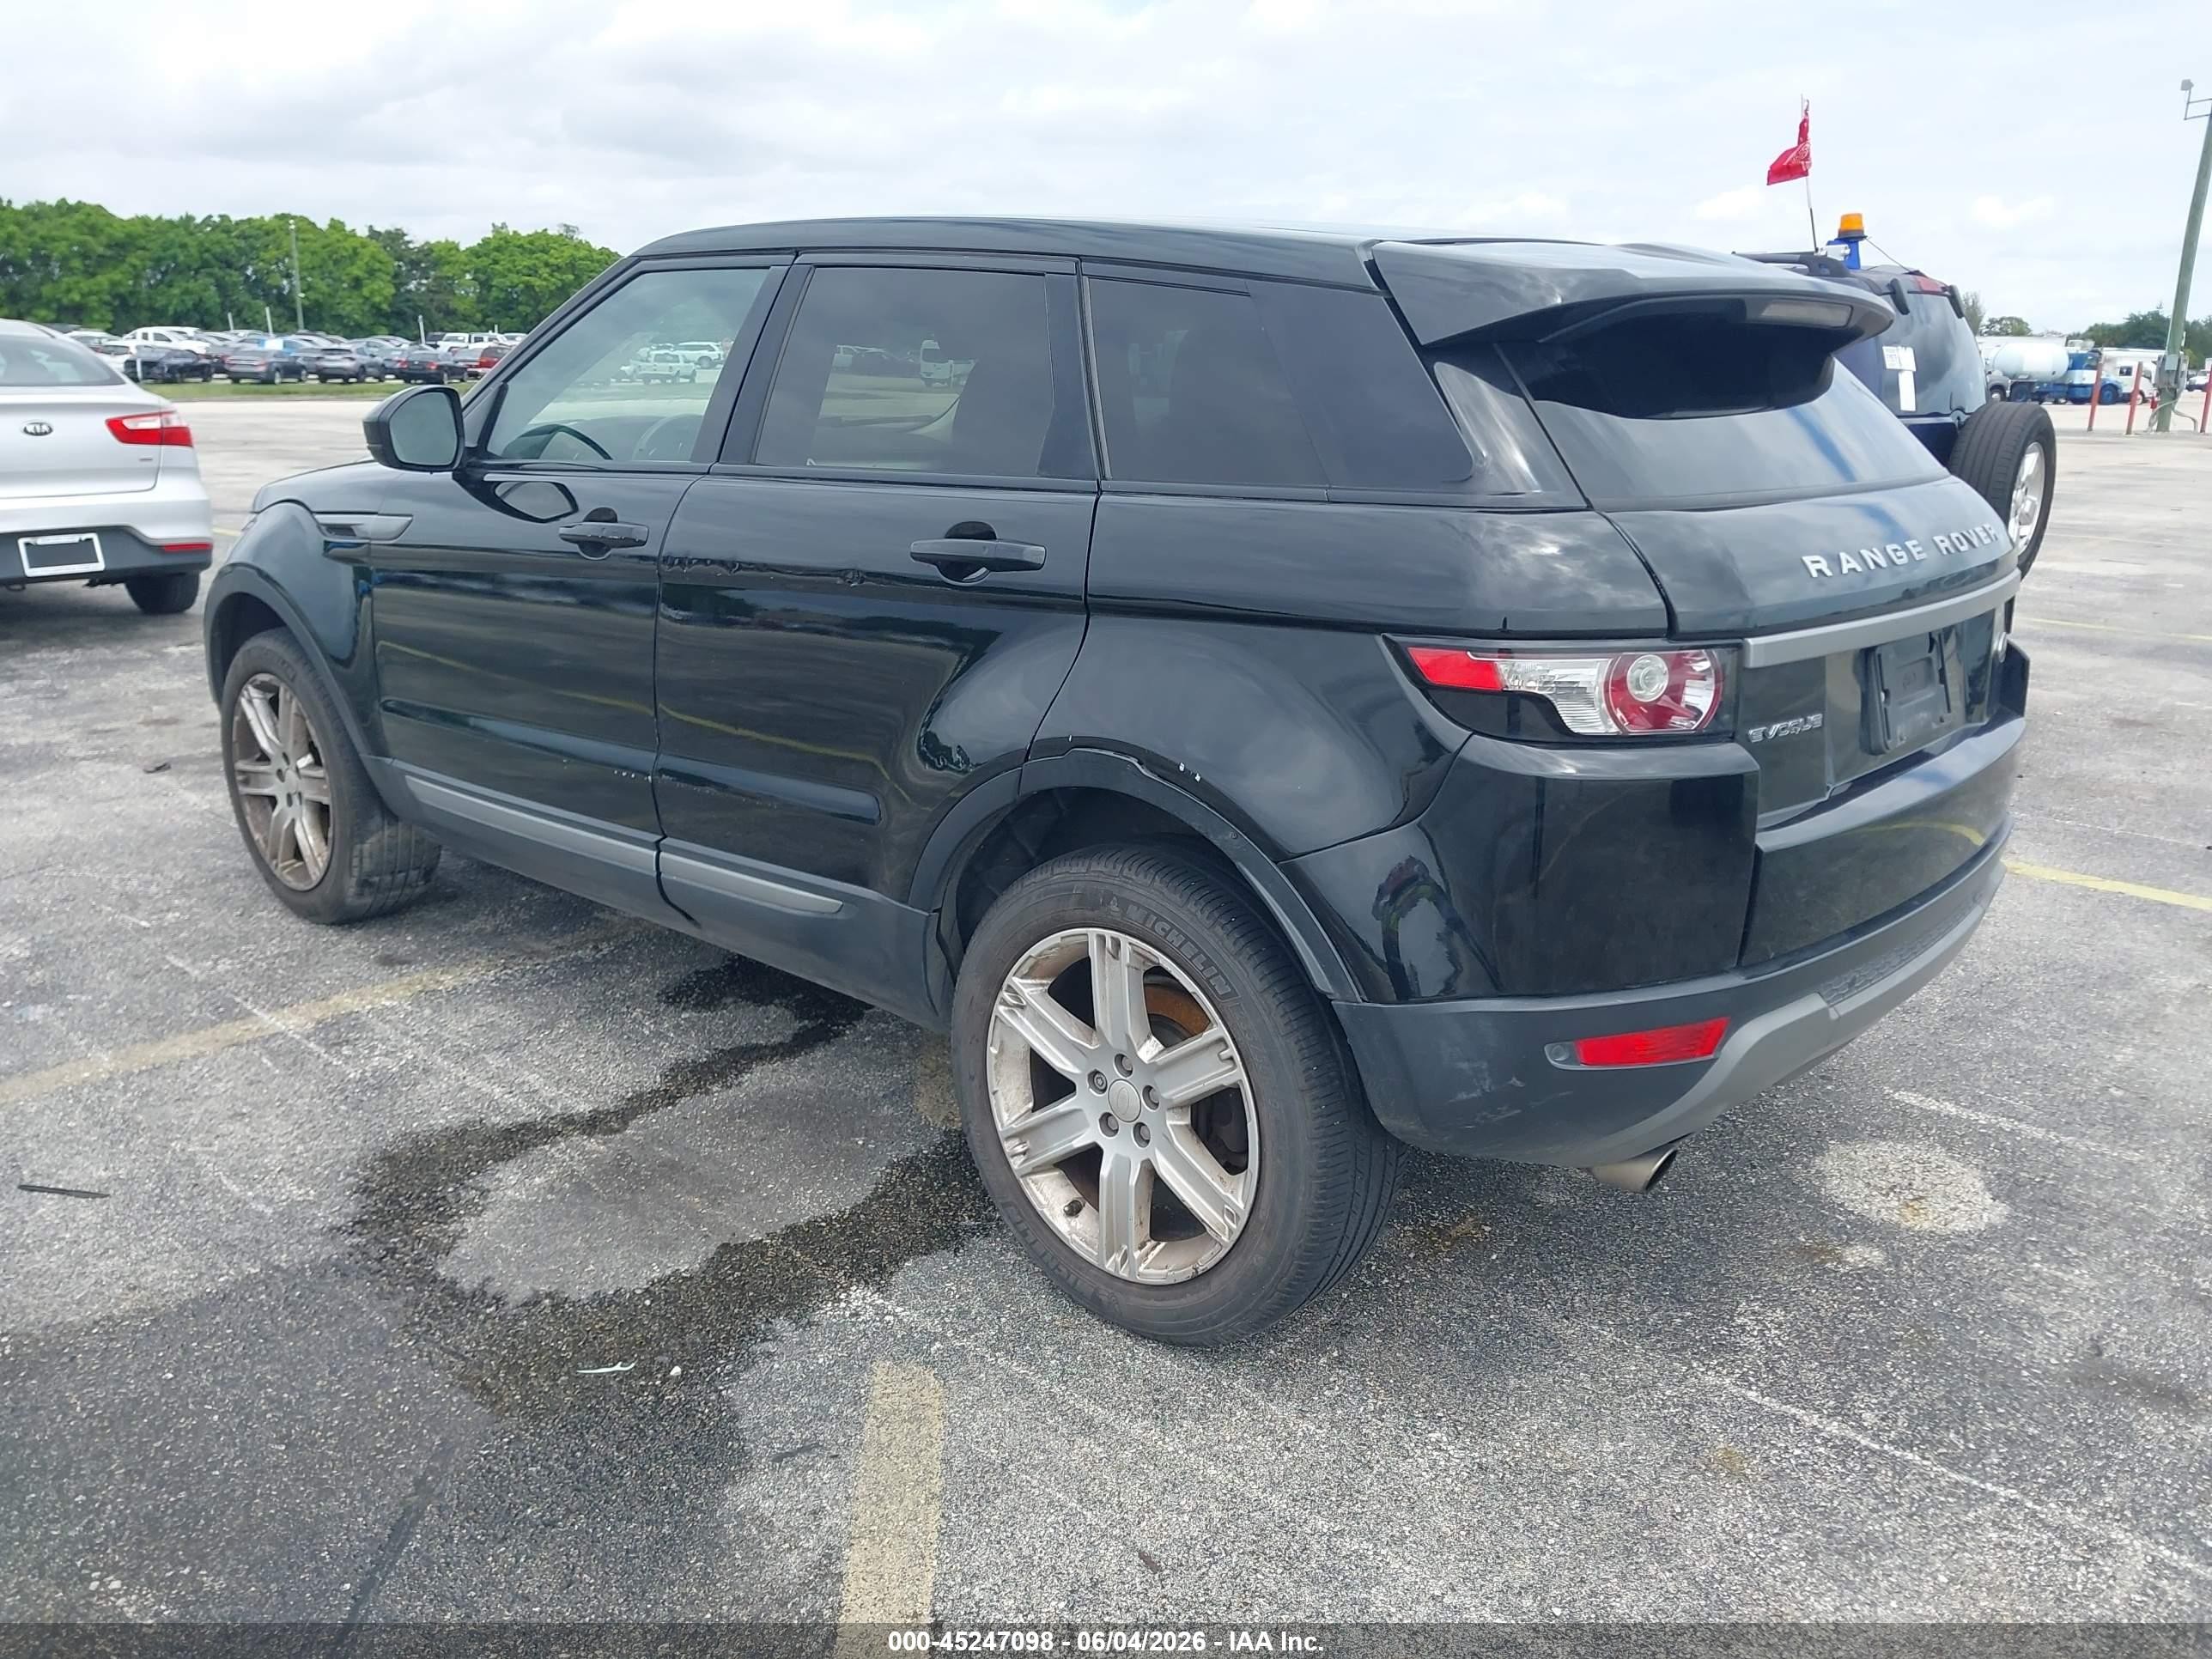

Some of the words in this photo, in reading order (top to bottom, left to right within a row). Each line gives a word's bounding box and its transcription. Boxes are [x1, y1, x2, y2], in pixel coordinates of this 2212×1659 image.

[23, 420, 53, 436] KIA
[1801, 539, 1928, 578] RANGE
[1931, 523, 1999, 556] ROVER
[1748, 713, 1823, 743] EVOQUE
[1126, 904, 1231, 996] MICHELIN
